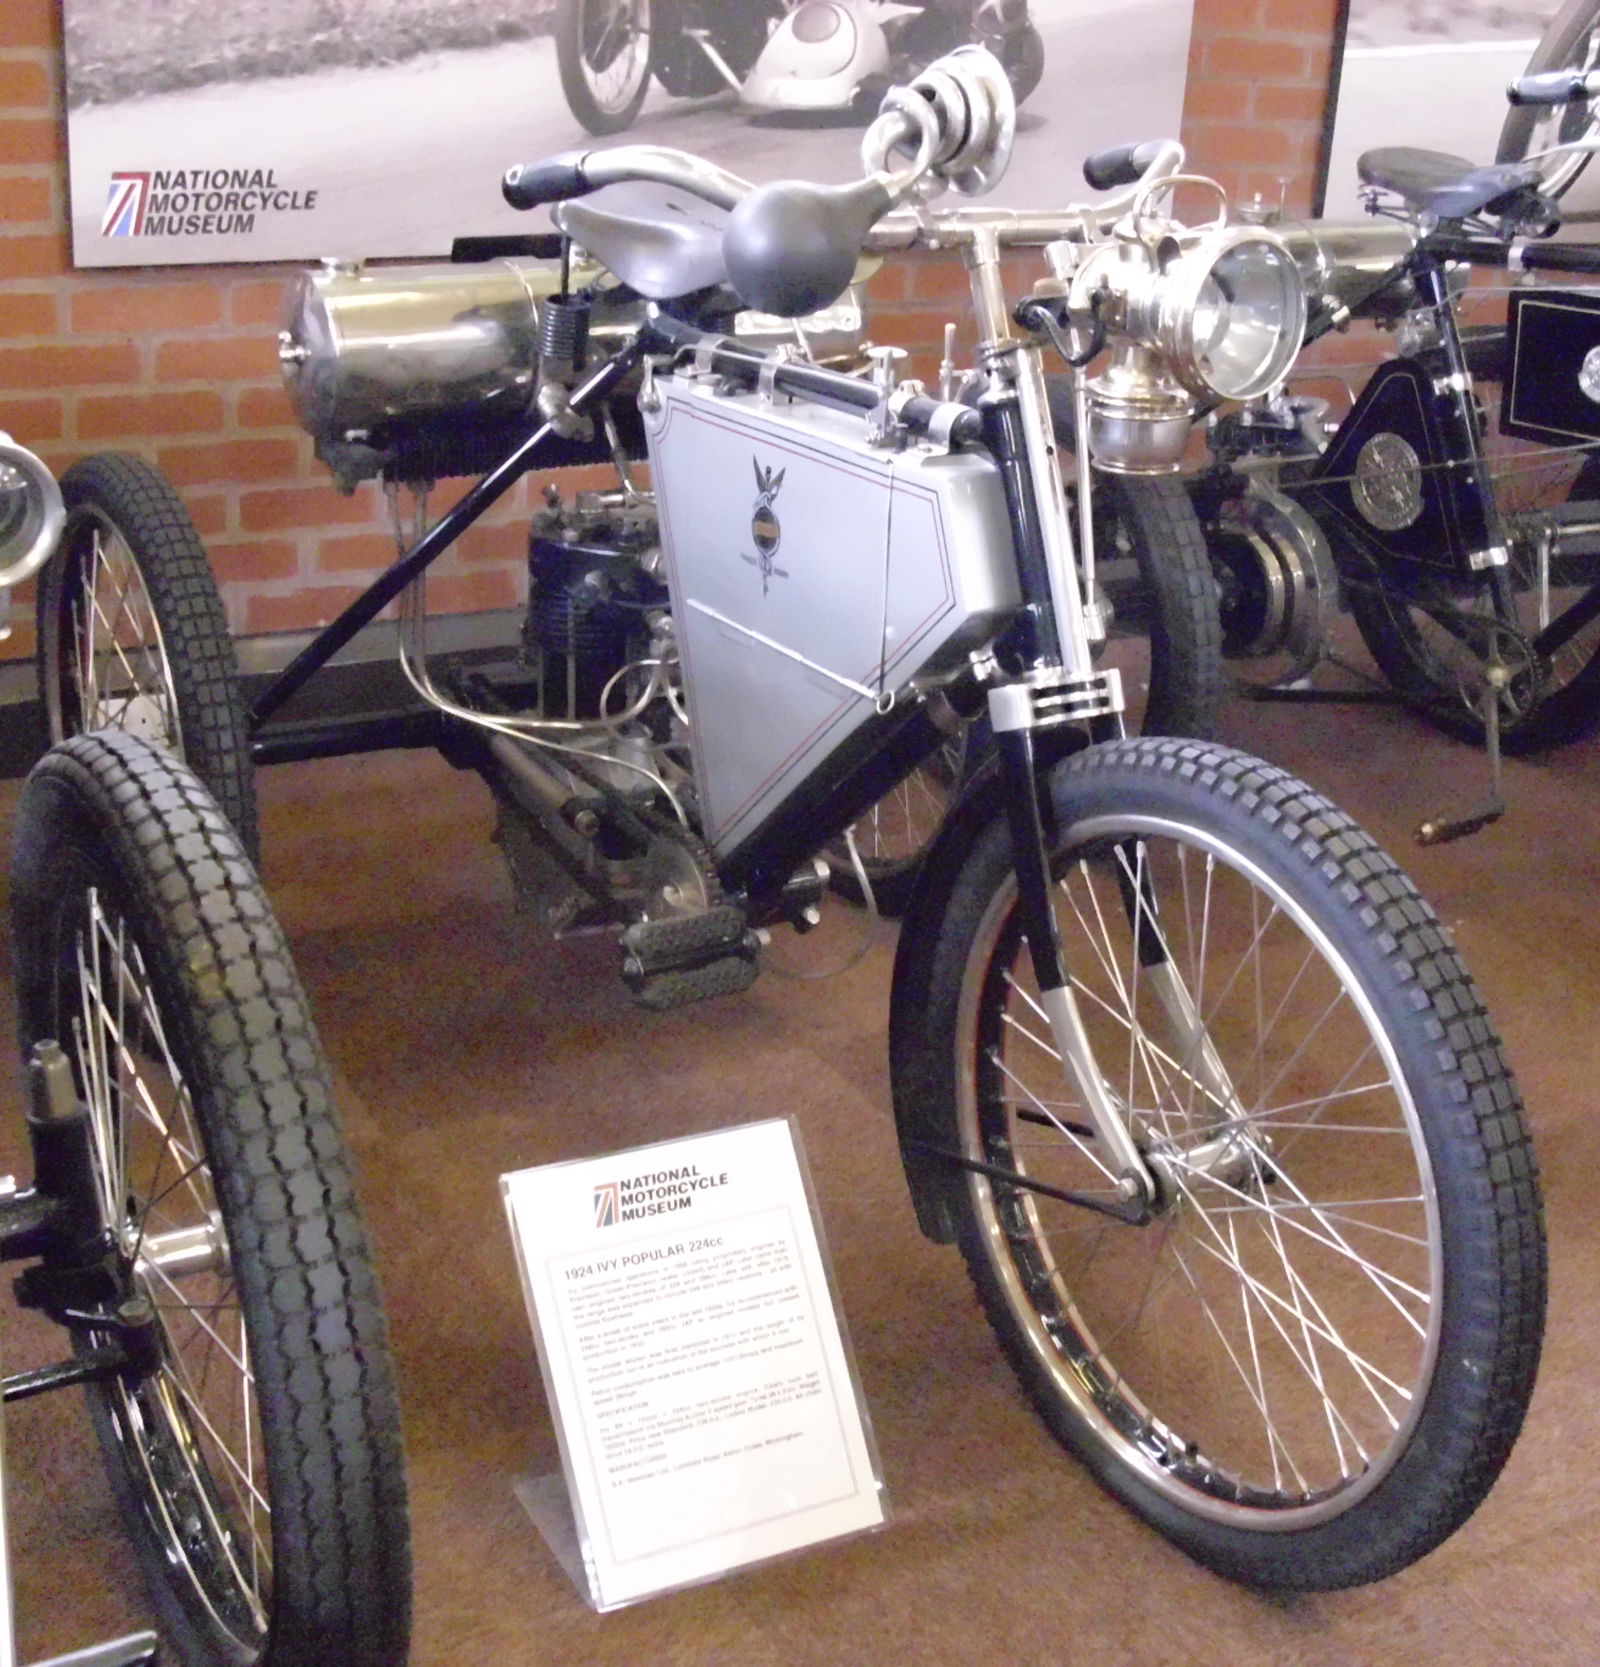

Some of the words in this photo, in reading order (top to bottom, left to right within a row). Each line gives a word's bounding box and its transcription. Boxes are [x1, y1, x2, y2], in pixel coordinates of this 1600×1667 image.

[153, 169, 278, 190] NATIONAL
[148, 190, 318, 213] MOTORCYCLE
[144, 214, 256, 236] MUSEUM
[620, 1165, 701, 1191] NATIONAL
[621, 1173, 729, 1207] MOTORCYCLE
[622, 1196, 692, 1222] MUSEUM
[564, 1264, 594, 1281] 1924
[597, 1258, 618, 1274] IVY
[622, 1243, 685, 1268] POPULAR
[688, 1236, 724, 1252] 224cc
